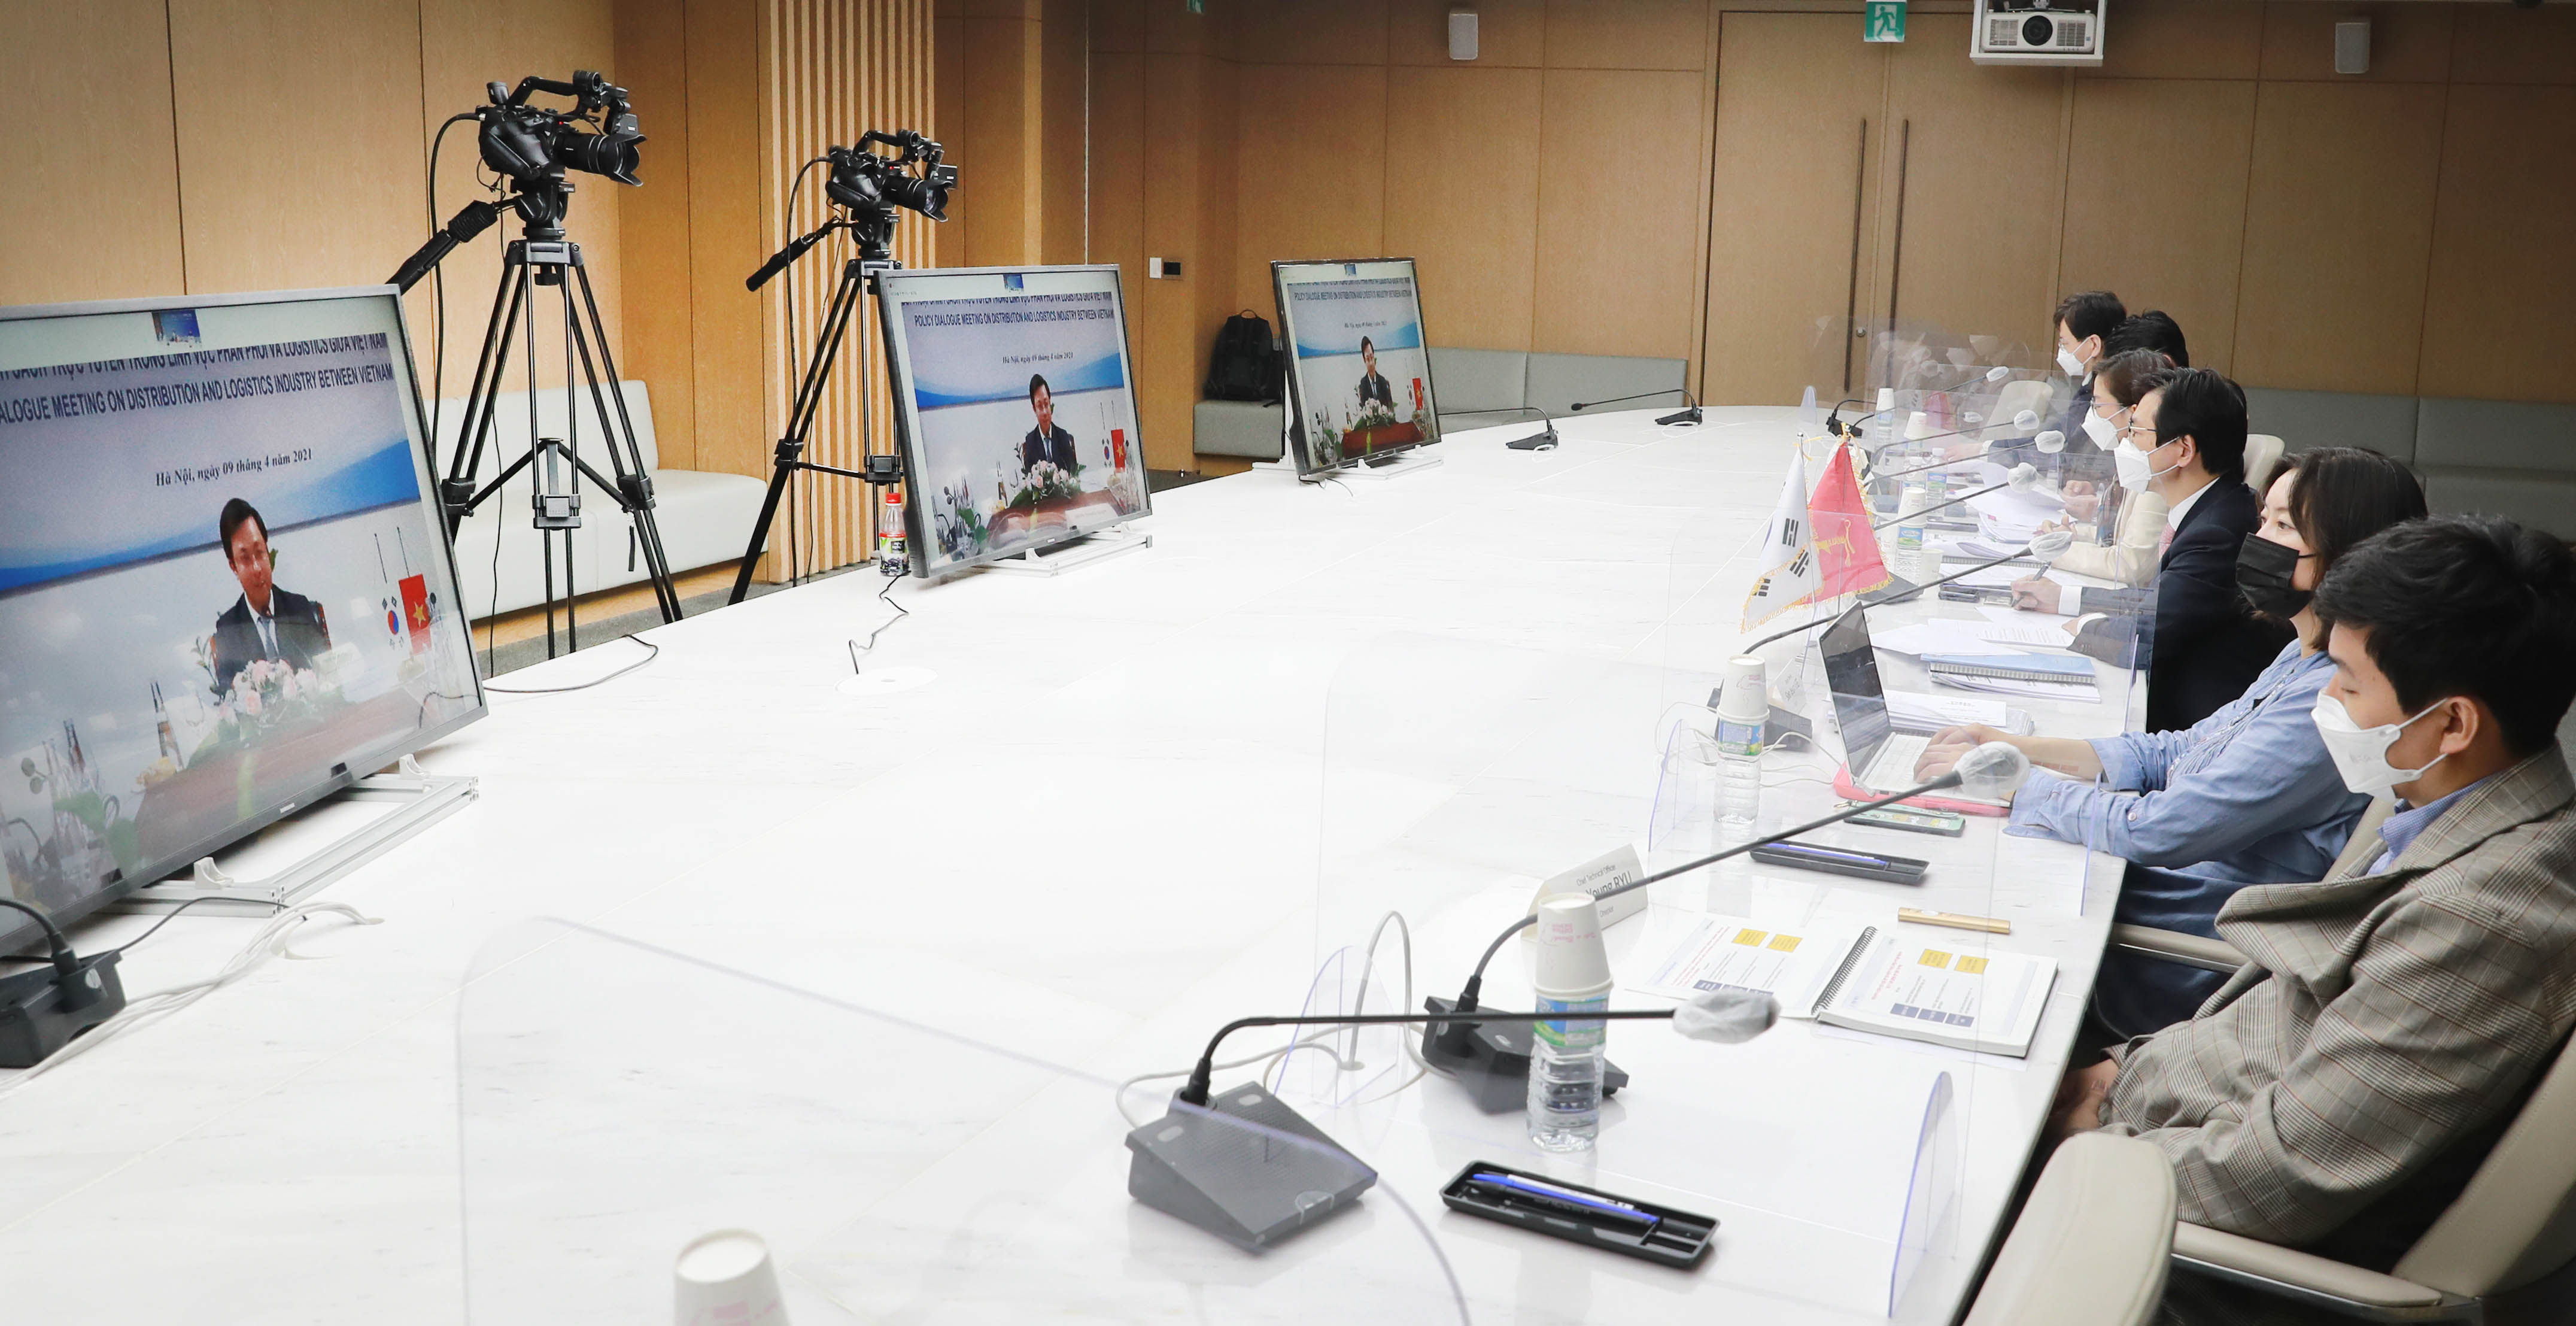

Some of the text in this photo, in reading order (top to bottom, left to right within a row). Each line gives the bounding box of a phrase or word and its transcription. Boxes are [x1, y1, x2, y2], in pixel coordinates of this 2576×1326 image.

[915, 314, 934, 326] POLICY
[934, 314, 961, 326] DIALOGUE
[961, 313, 983, 325] MEETING
[984, 313, 991, 324] ON
[992, 311, 1023, 324] DISTRIBUTION
[1023, 311, 1034, 323] AND
[1034, 311, 1056, 322] LOGISTICS
[1056, 310, 1077, 321] INDUSTRY
[1077, 309, 1096, 321] BETWEEN
[51, 392, 106, 418] MEETING
[107, 389, 126, 413] ON
[126, 382, 201, 411] DISTRIBUTION
[202, 380, 223, 402] AND
[223, 375, 274, 399] LOGISTICS
[274, 371, 317, 393] INDUSTRY
[318, 366, 359, 389] BETWEEN
[358, 363, 394, 384] VIETNAM
[156, 471, 171, 486] Hà
[198, 465, 220, 480] ngày
[223, 461, 233, 475] 09
[265, 455, 269, 468] 4
[293, 448, 312, 463] 2021
[1614, 871, 1632, 888] RYU
